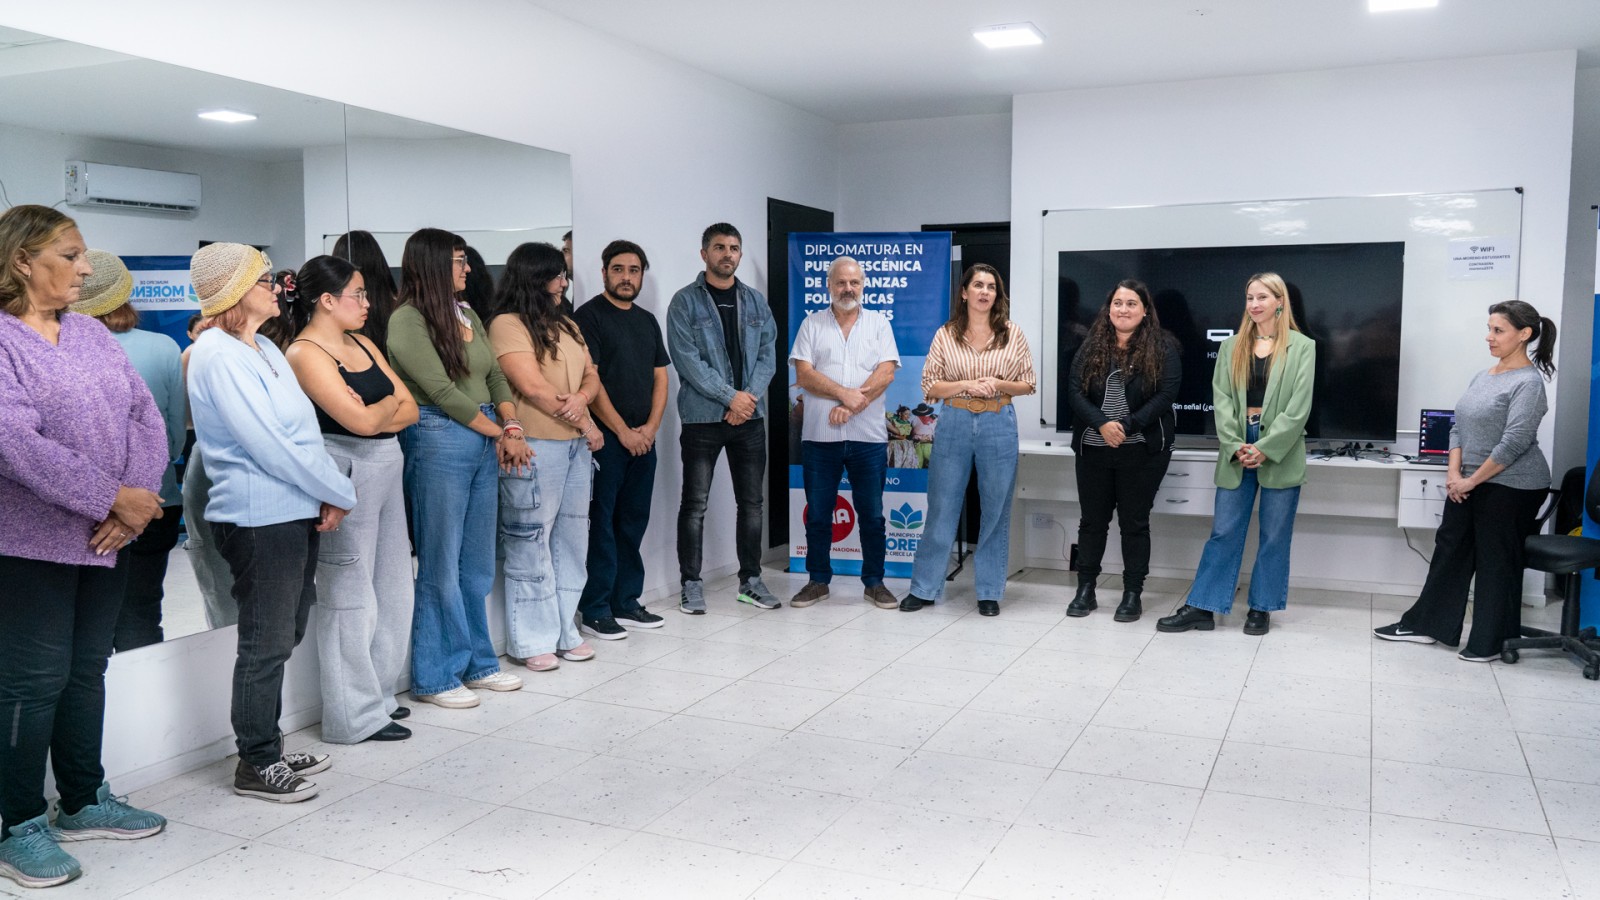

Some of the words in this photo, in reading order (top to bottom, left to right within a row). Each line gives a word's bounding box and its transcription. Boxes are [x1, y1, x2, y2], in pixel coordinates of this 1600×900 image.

[805, 244, 900, 256] DIPLOMATURA
[905, 244, 923, 255] EN
[805, 260, 830, 272] PUE
[859, 257, 922, 271] ESCÉNICA
[804, 276, 822, 288] DE
[864, 276, 908, 288] ANZAS
[804, 293, 894, 305] FOLRICAS
[886, 537, 918, 551] ORE
